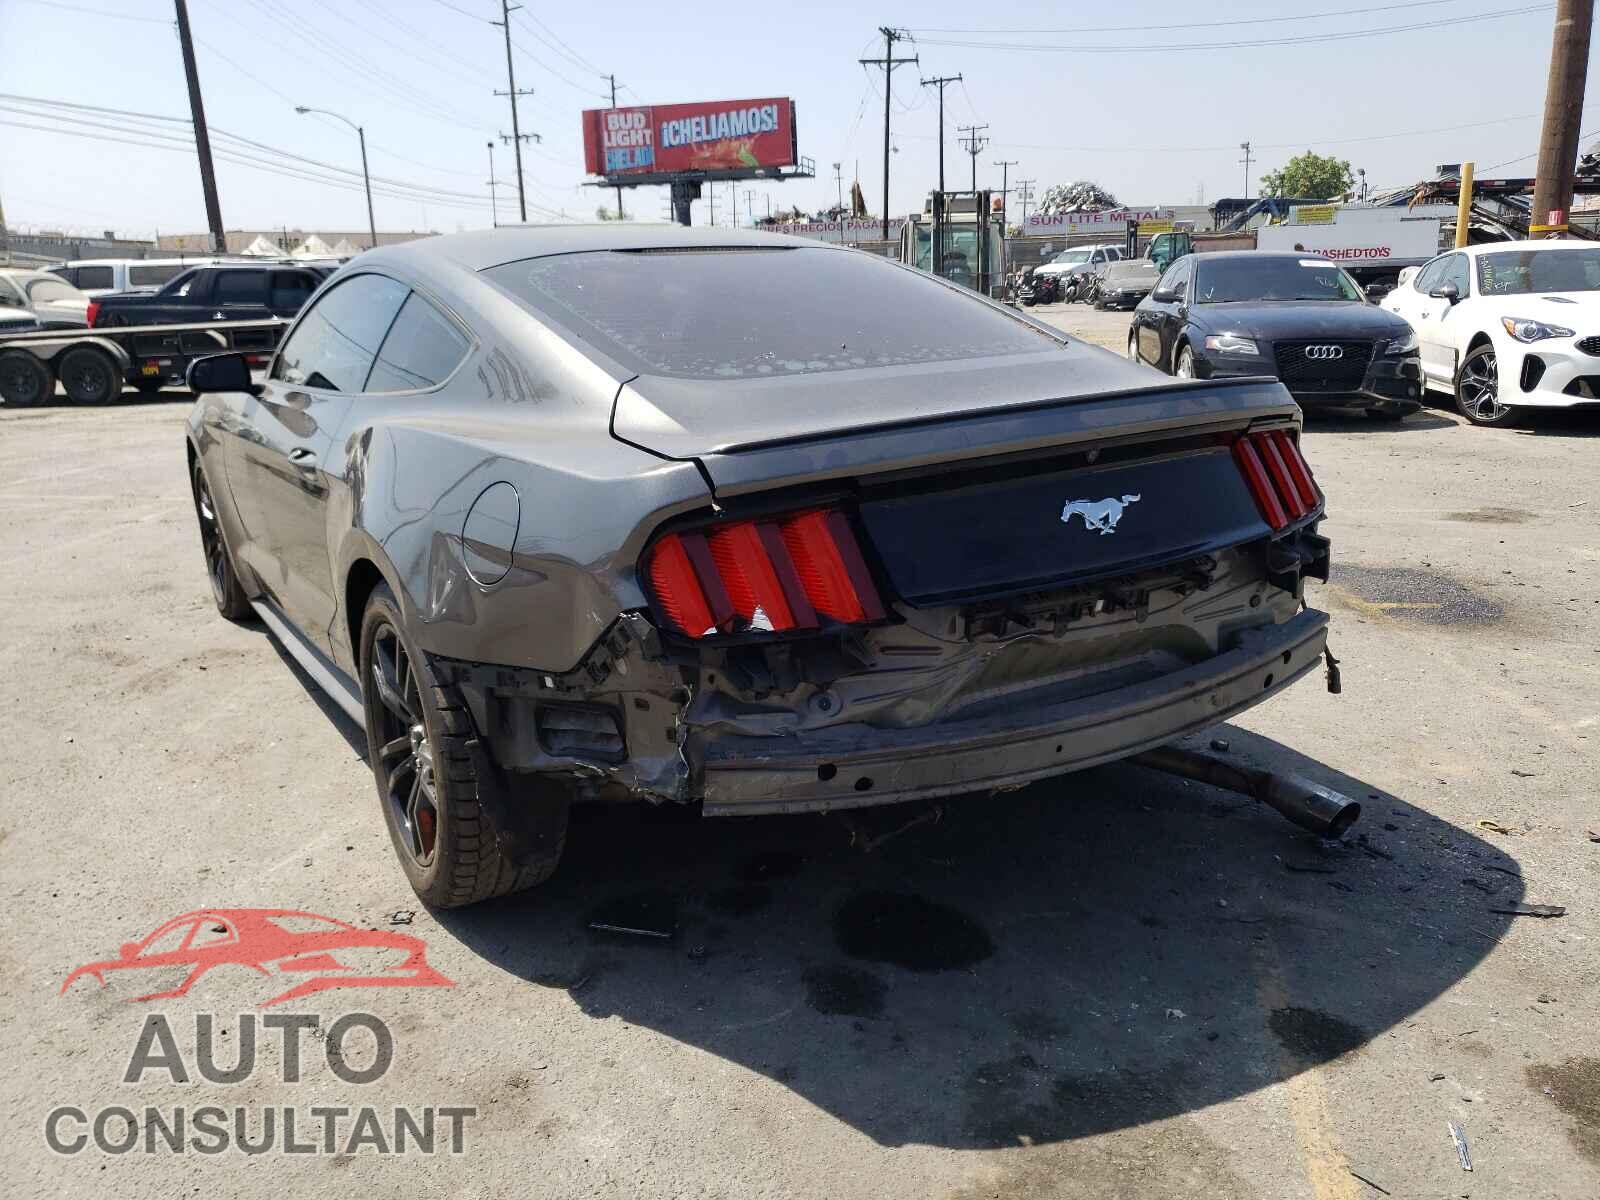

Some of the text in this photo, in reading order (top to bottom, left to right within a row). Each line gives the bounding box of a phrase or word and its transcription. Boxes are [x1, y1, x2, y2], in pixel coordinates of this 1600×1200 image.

[608, 112, 646, 130] BUD
[661, 104, 778, 149] ¡CHELIAMOS!
[604, 129, 652, 147] LIGHT
[1030, 208, 1176, 226] SUN LITE METALS
[793, 222, 843, 233] PRECIOS
[1303, 246, 1391, 260] ASHEDTOYS
